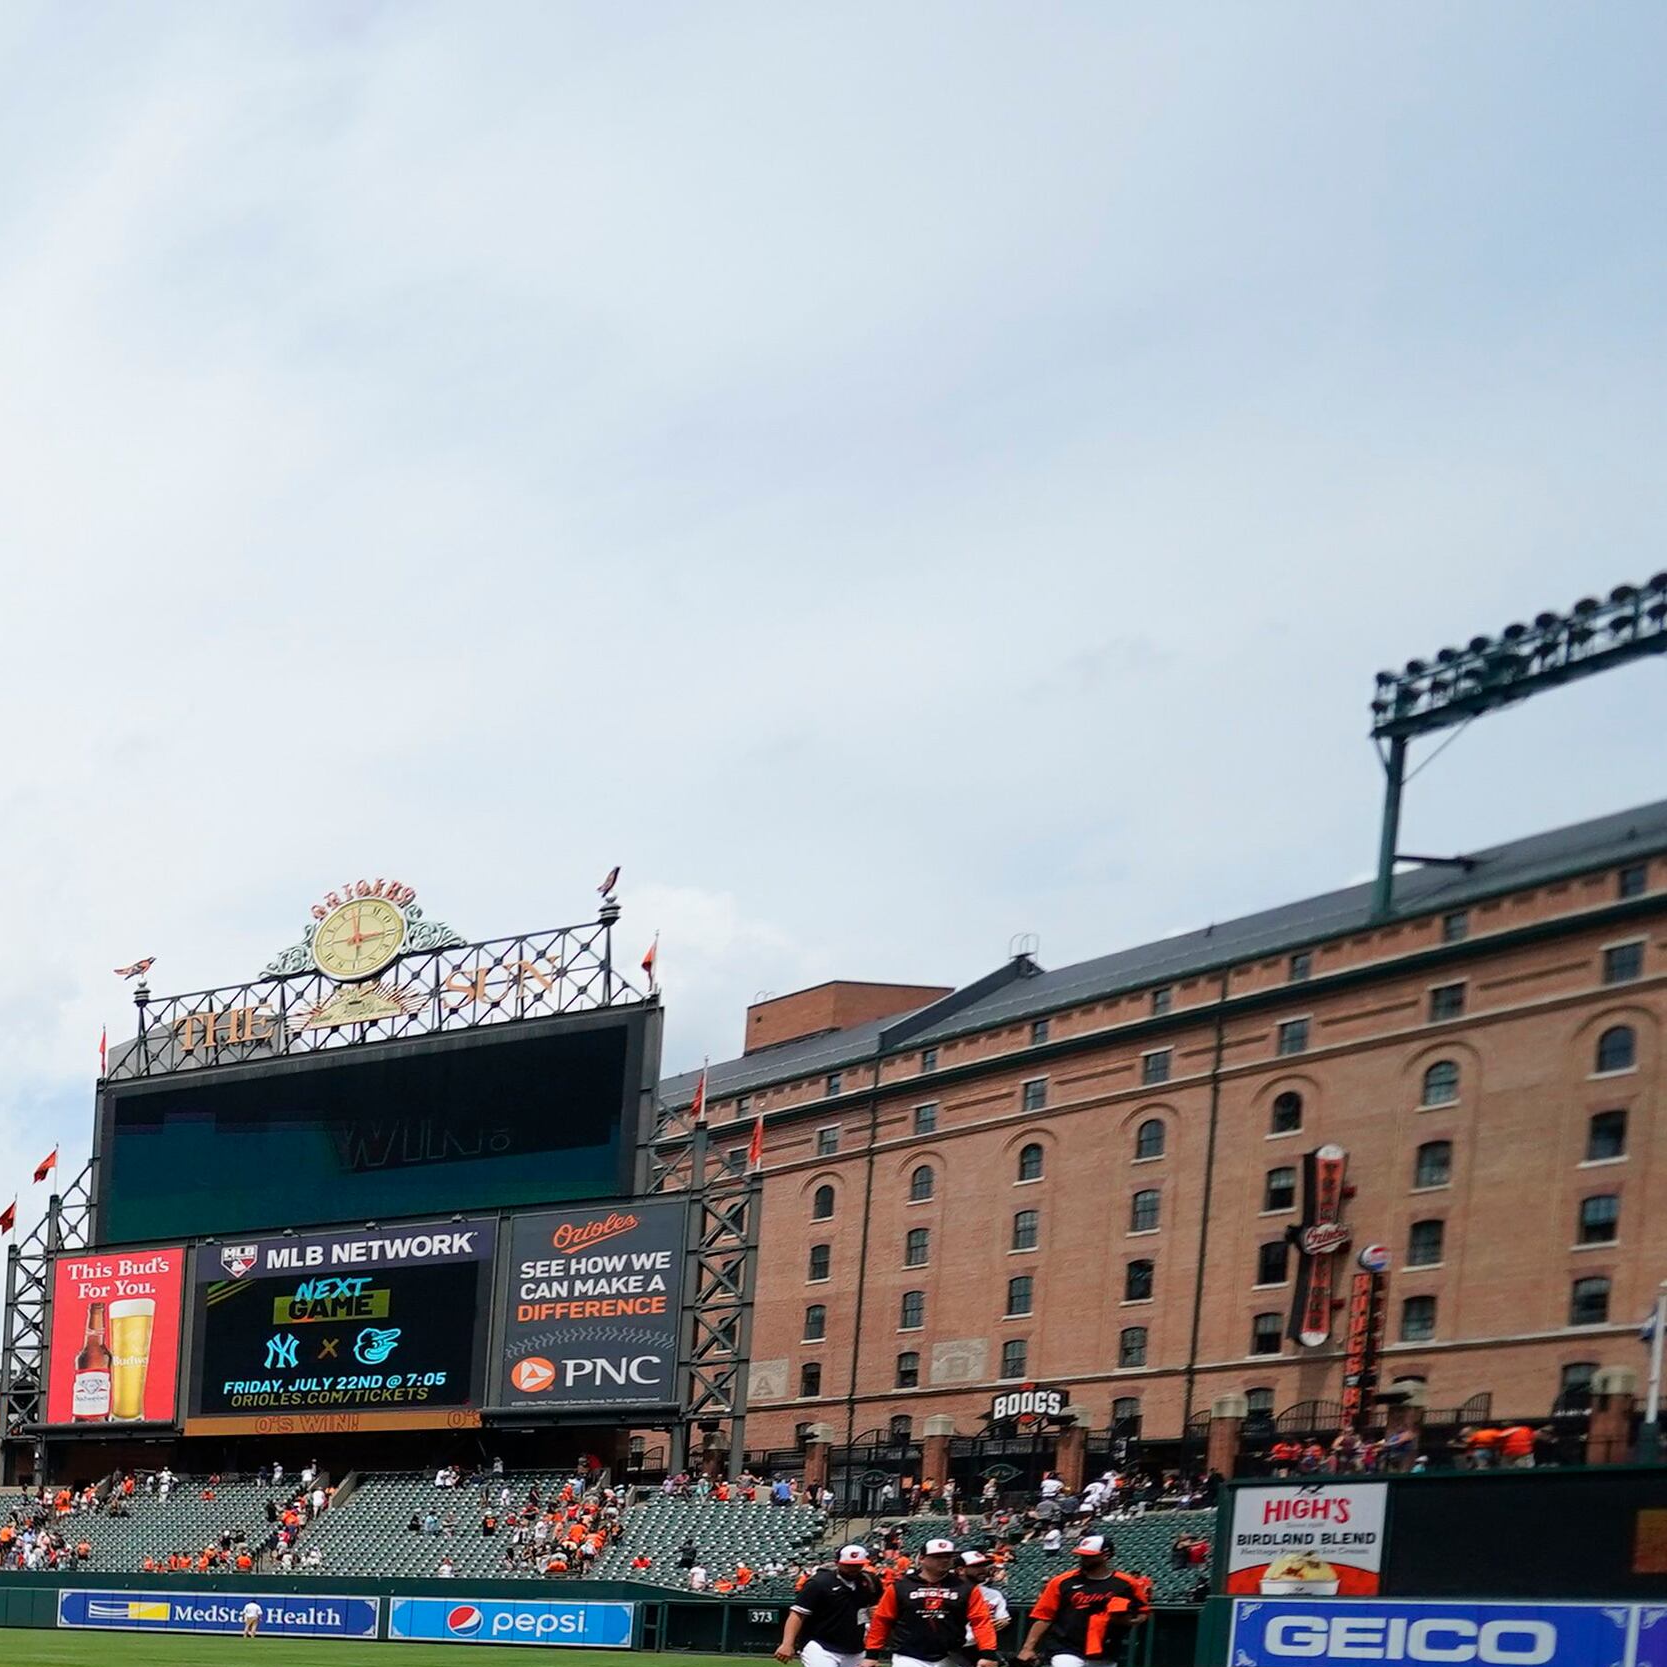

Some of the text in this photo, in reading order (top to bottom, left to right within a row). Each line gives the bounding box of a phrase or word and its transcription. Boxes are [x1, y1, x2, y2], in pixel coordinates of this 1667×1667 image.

[172, 1003, 276, 1053] THE
[443, 956, 561, 1010] SUN
[553, 1212, 639, 1254] Orioles
[267, 1232, 473, 1269] MLB NETWORK
[67, 1257, 170, 1280] This Bud's
[520, 1251, 673, 1279] SEE HOW WE
[78, 1280, 156, 1299] For You.
[294, 1277, 373, 1301] NEXT
[520, 1274, 666, 1300] CAN MAKE A
[288, 1294, 373, 1320] GAME
[517, 1297, 667, 1322] DIFFERENCE
[223, 1372, 447, 1395] FRIDAY, JULY 22ND @ 7:05
[562, 1355, 661, 1387] PNC
[231, 1387, 429, 1407] ORIOLES.COM/TICKETS
[993, 1389, 1061, 1420] BOOG'S
[299, 1414, 360, 1433] WIN!
[1263, 1498, 1351, 1526] HIGH'S
[1236, 1531, 1377, 1546] BIRDLAND BLEND
[174, 1604, 342, 1627] MedSta Health
[492, 1610, 586, 1638] pepsi
[751, 1611, 773, 1624] 373
[1264, 1615, 1559, 1666] GEICO
